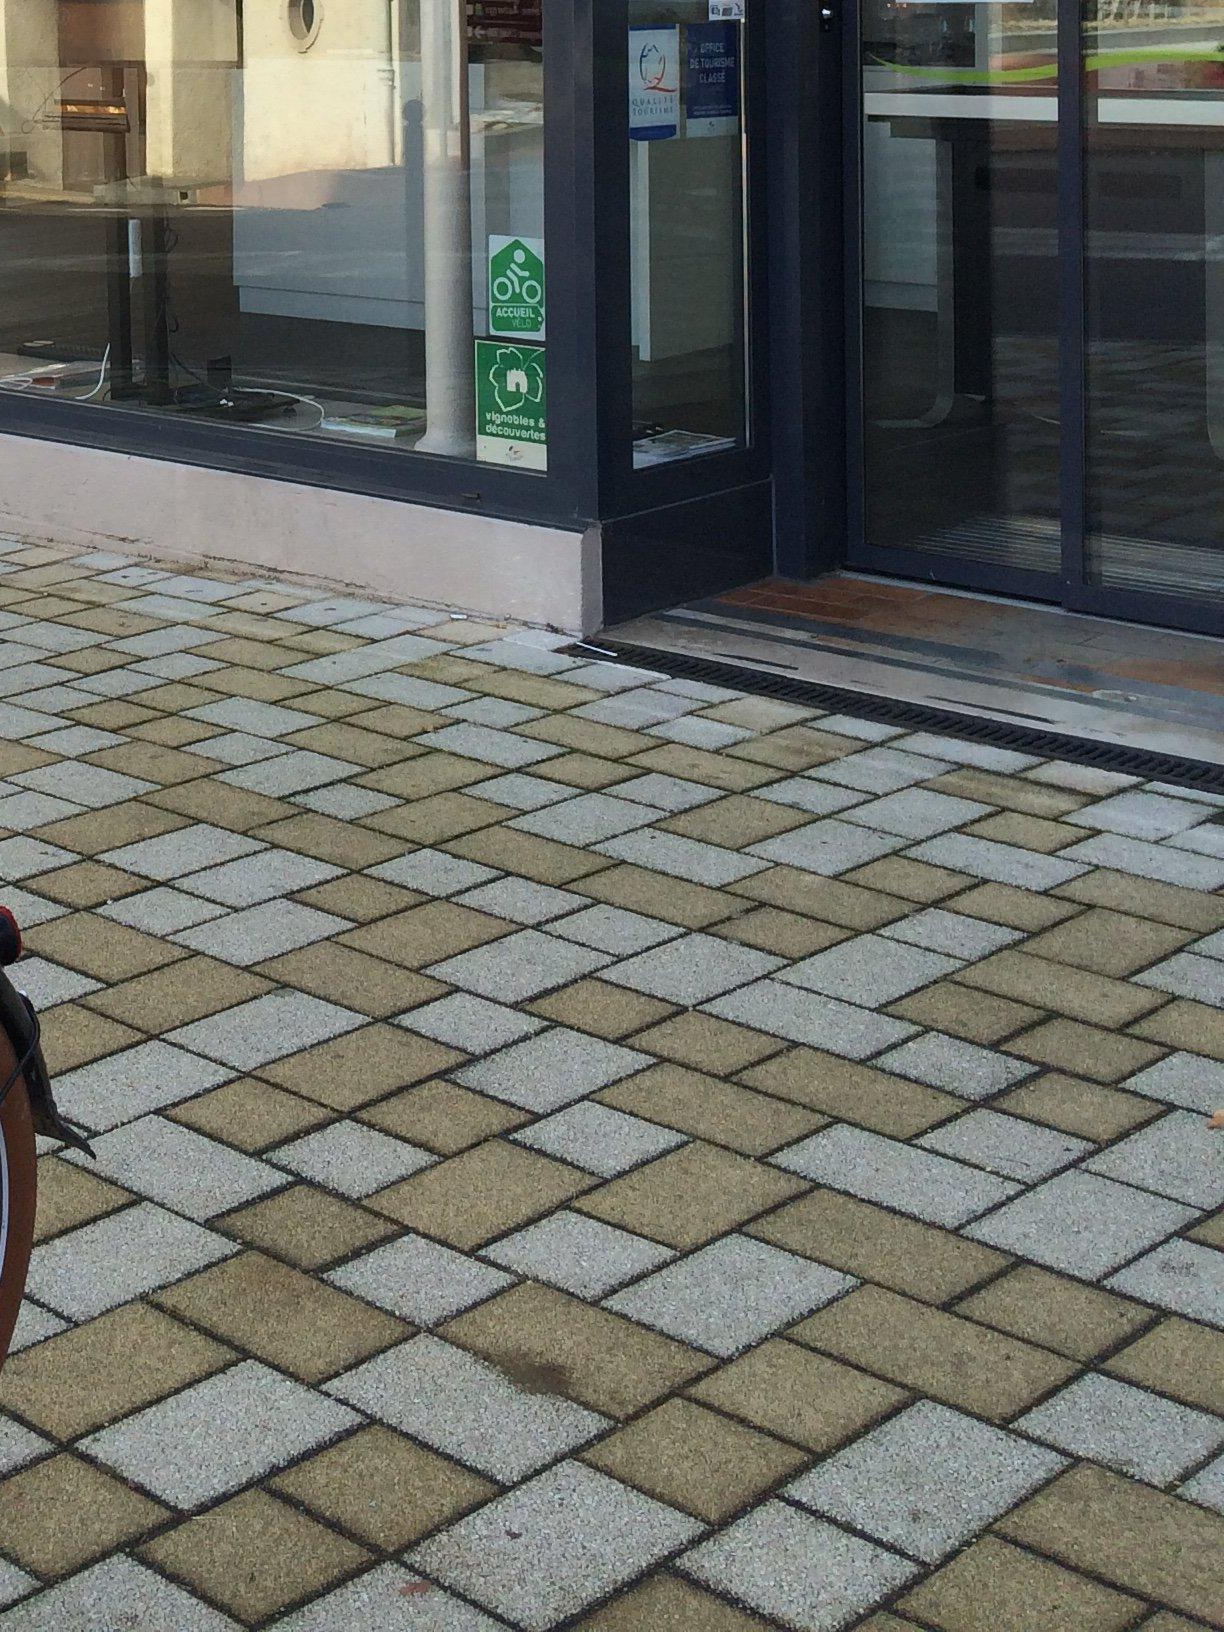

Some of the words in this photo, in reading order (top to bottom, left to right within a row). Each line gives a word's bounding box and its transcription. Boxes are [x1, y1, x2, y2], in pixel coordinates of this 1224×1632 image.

[689, 58, 700, 69] DE
[700, 56, 735, 69] TOURISME
[495, 307, 536, 319] ACCUEIL
[485, 410, 535, 427] vignobles
[538, 417, 545, 429] &
[485, 422, 546, 441] découvertes
